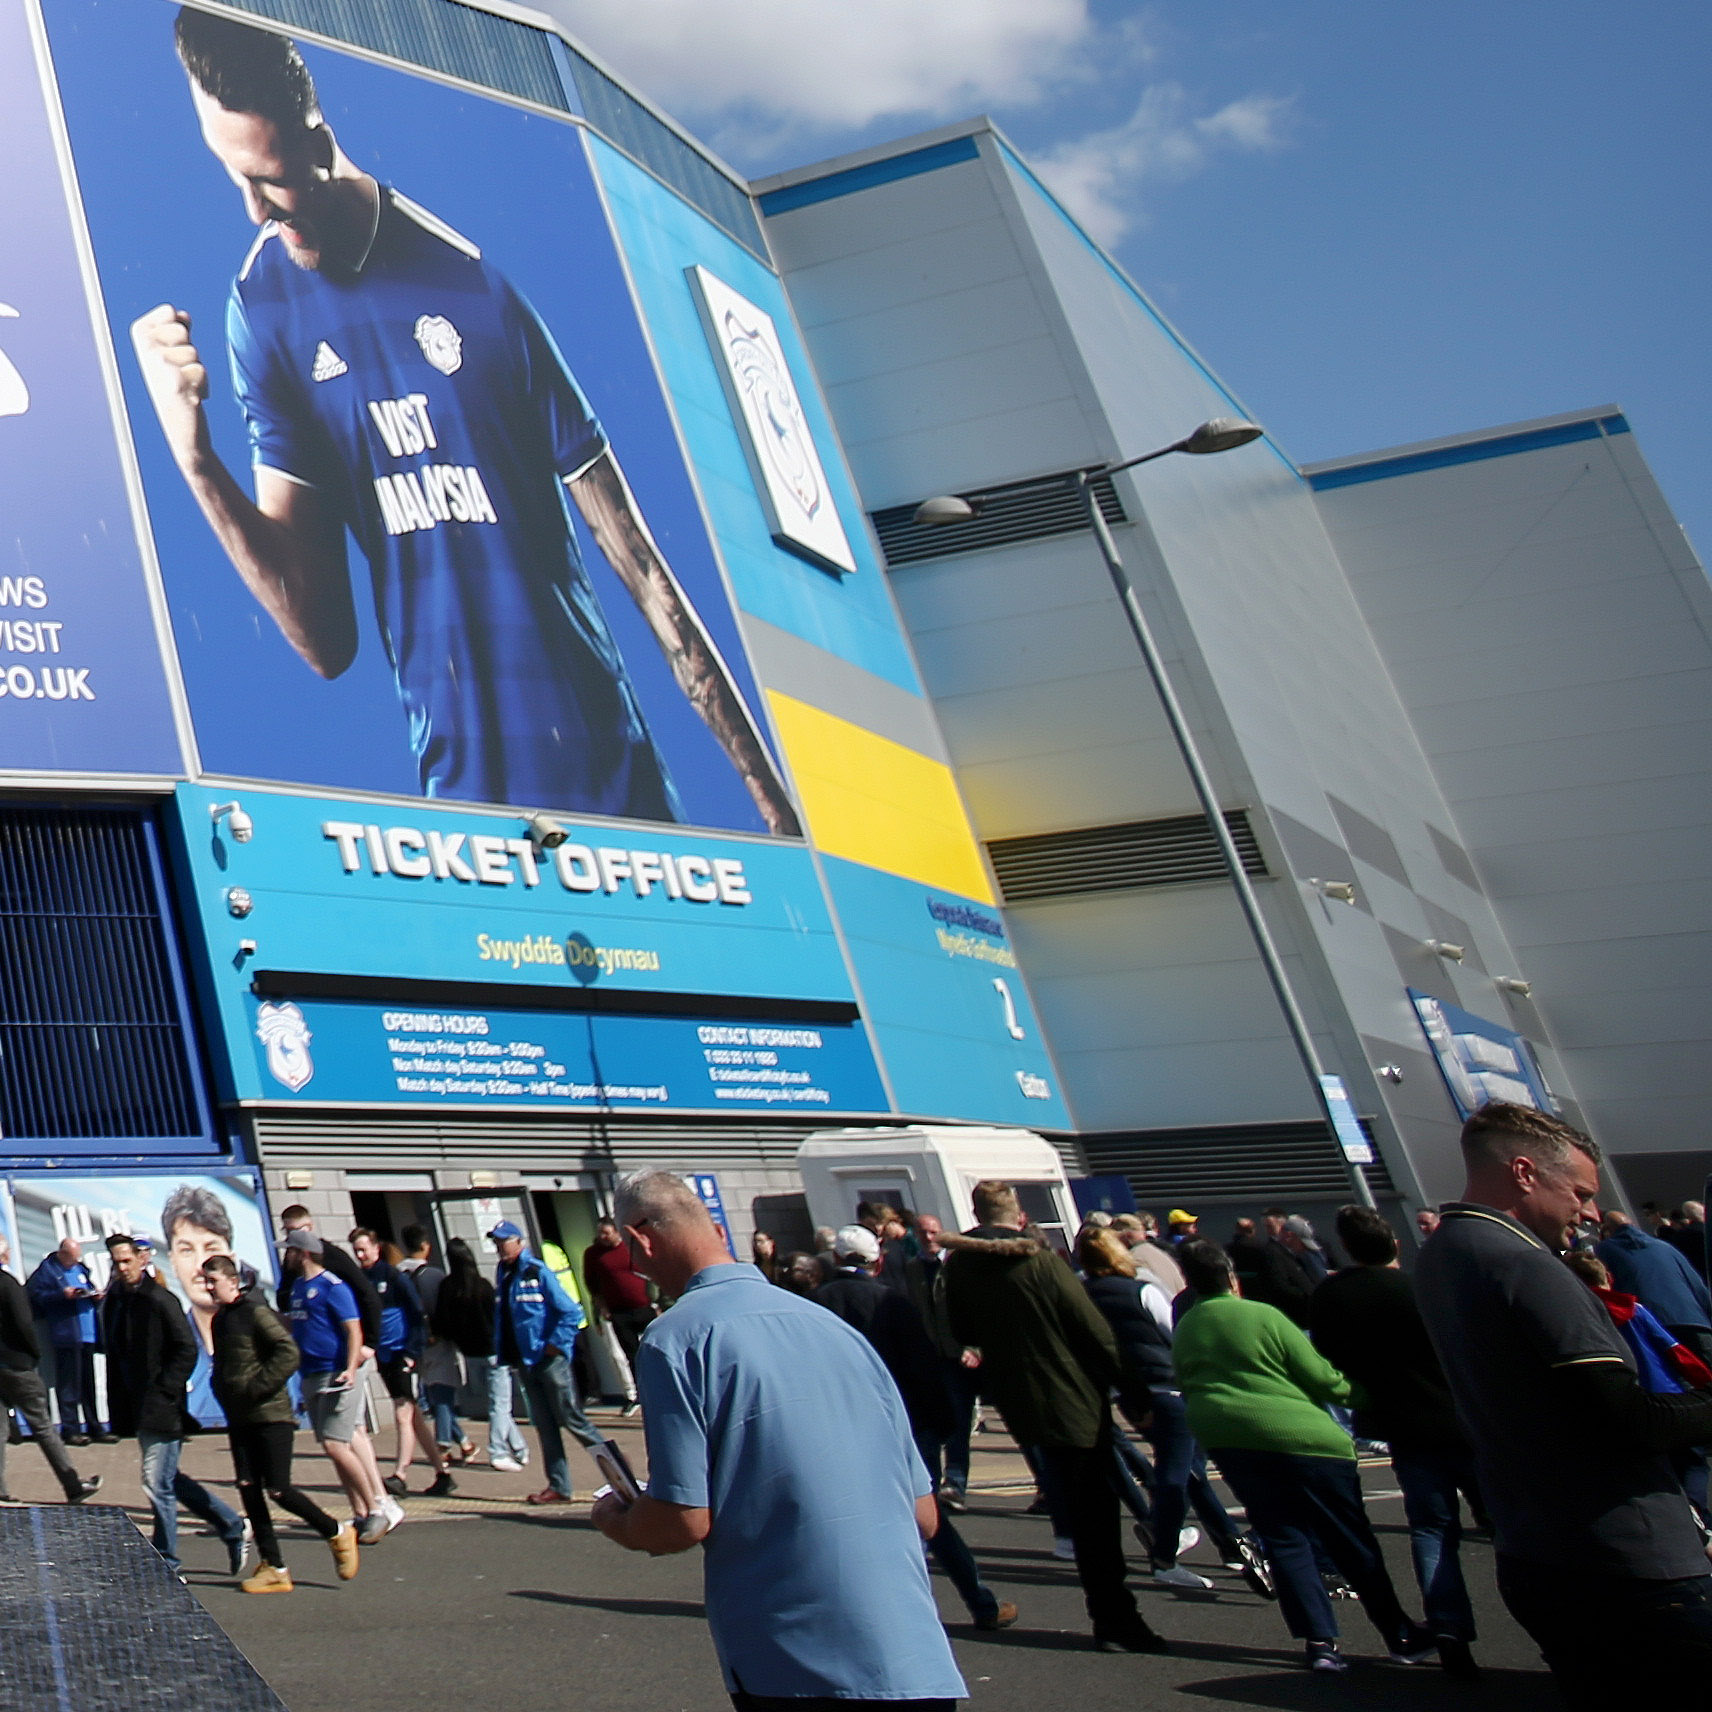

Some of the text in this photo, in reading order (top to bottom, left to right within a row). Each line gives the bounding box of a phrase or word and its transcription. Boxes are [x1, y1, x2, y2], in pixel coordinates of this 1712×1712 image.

[322, 820, 752, 906] TICKET OFFICE
[476, 932, 565, 970] Swyddfa
